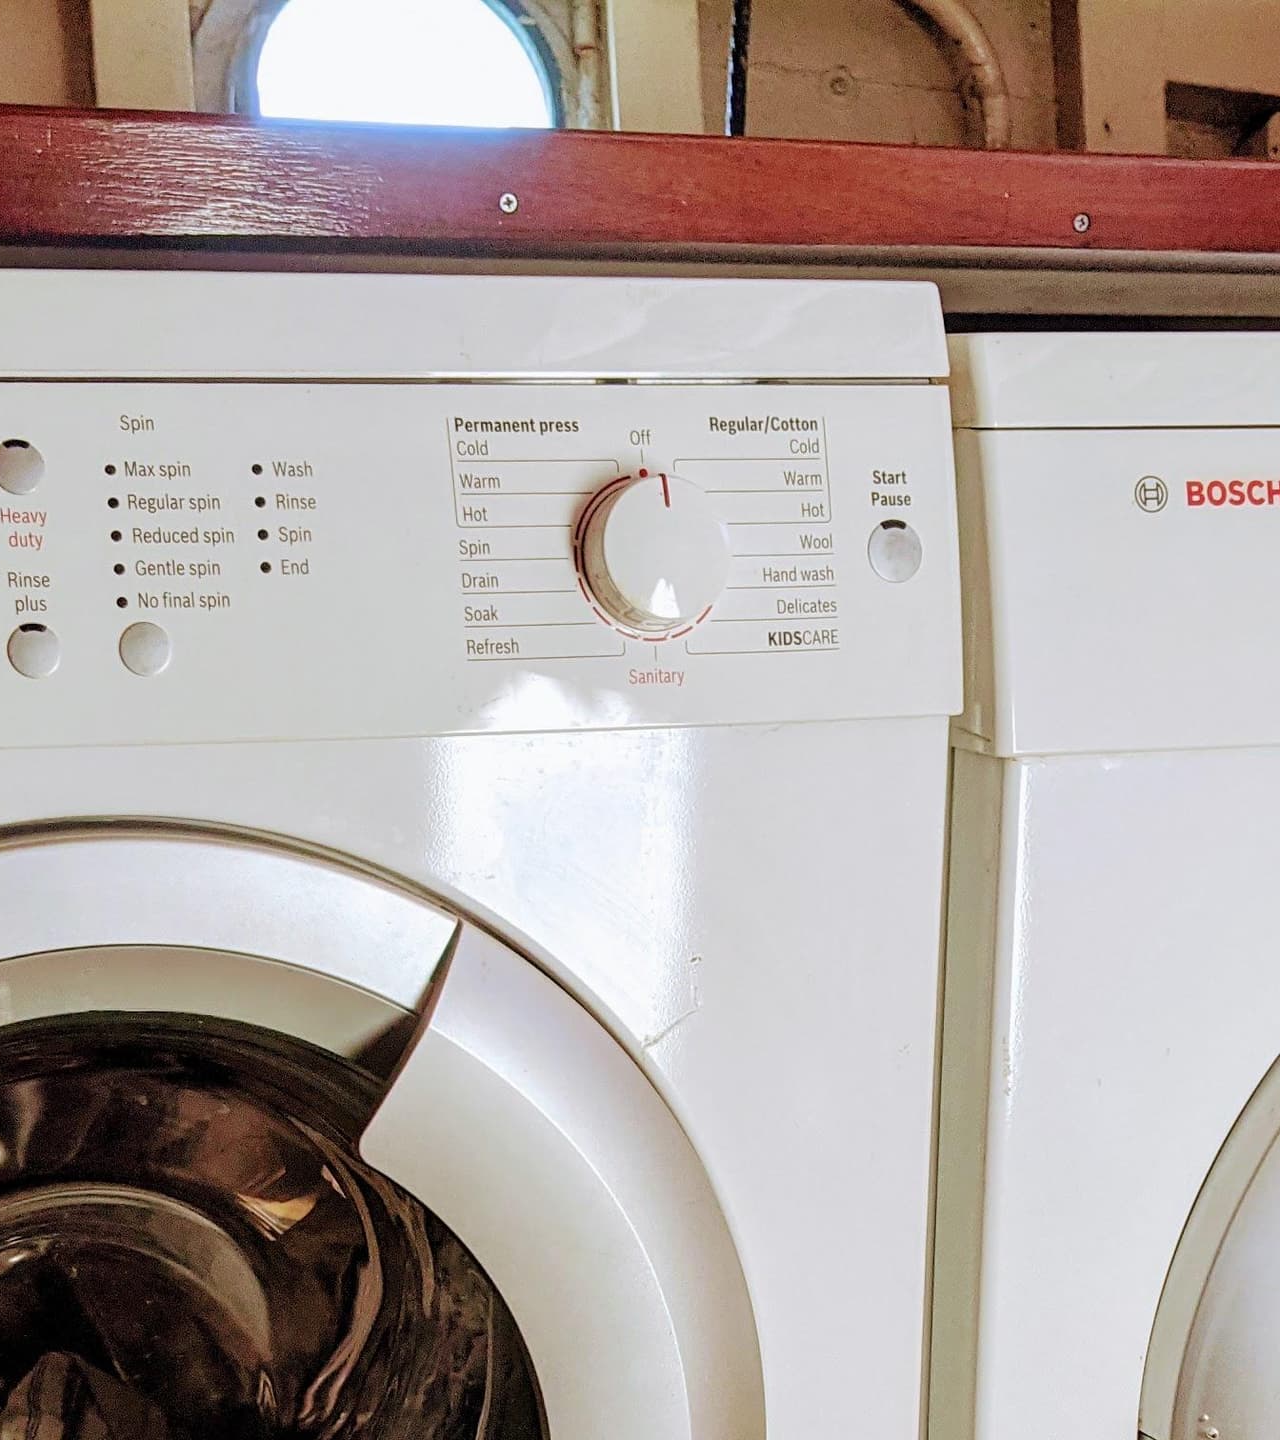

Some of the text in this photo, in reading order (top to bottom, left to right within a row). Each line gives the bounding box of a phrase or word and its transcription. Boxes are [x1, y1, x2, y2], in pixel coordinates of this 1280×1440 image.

[120, 415, 154, 434] Spin
[454, 418, 579, 435] Permanent press
[709, 416, 818, 435] Regular/Cotton
[630, 430, 651, 445] Off
[457, 440, 488, 456] Cold
[790, 439, 819, 454] Cold
[124, 461, 191, 479] Max spin
[272, 461, 313, 477] Wash
[459, 474, 500, 488] Warm
[784, 471, 822, 486] Warm
[873, 470, 907, 485] Start
[127, 494, 220, 513] Regular spin
[275, 494, 317, 509] Rinse
[871, 492, 911, 506] Pause
[0, 508, 47, 527] Heavy
[463, 507, 488, 522] Hot
[801, 503, 824, 517] Hot
[9, 531, 43, 550] duty
[132, 528, 234, 546] Reduced spin
[278, 527, 312, 545] Spin
[800, 534, 832, 549] Wool
[459, 540, 490, 557] Spin
[135, 560, 220, 578] Gentle spin
[281, 559, 309, 575] End
[763, 566, 834, 582] Hand wash
[8, 572, 50, 588] Rinse
[462, 573, 499, 588] Drain
[15, 596, 47, 614] plus
[138, 593, 230, 610] No final spin
[777, 599, 837, 614] Delicates
[464, 606, 498, 621] Soak
[768, 629, 839, 646] KIDSCARE
[467, 639, 519, 655] Refresh
[629, 669, 684, 686] Sanitary
